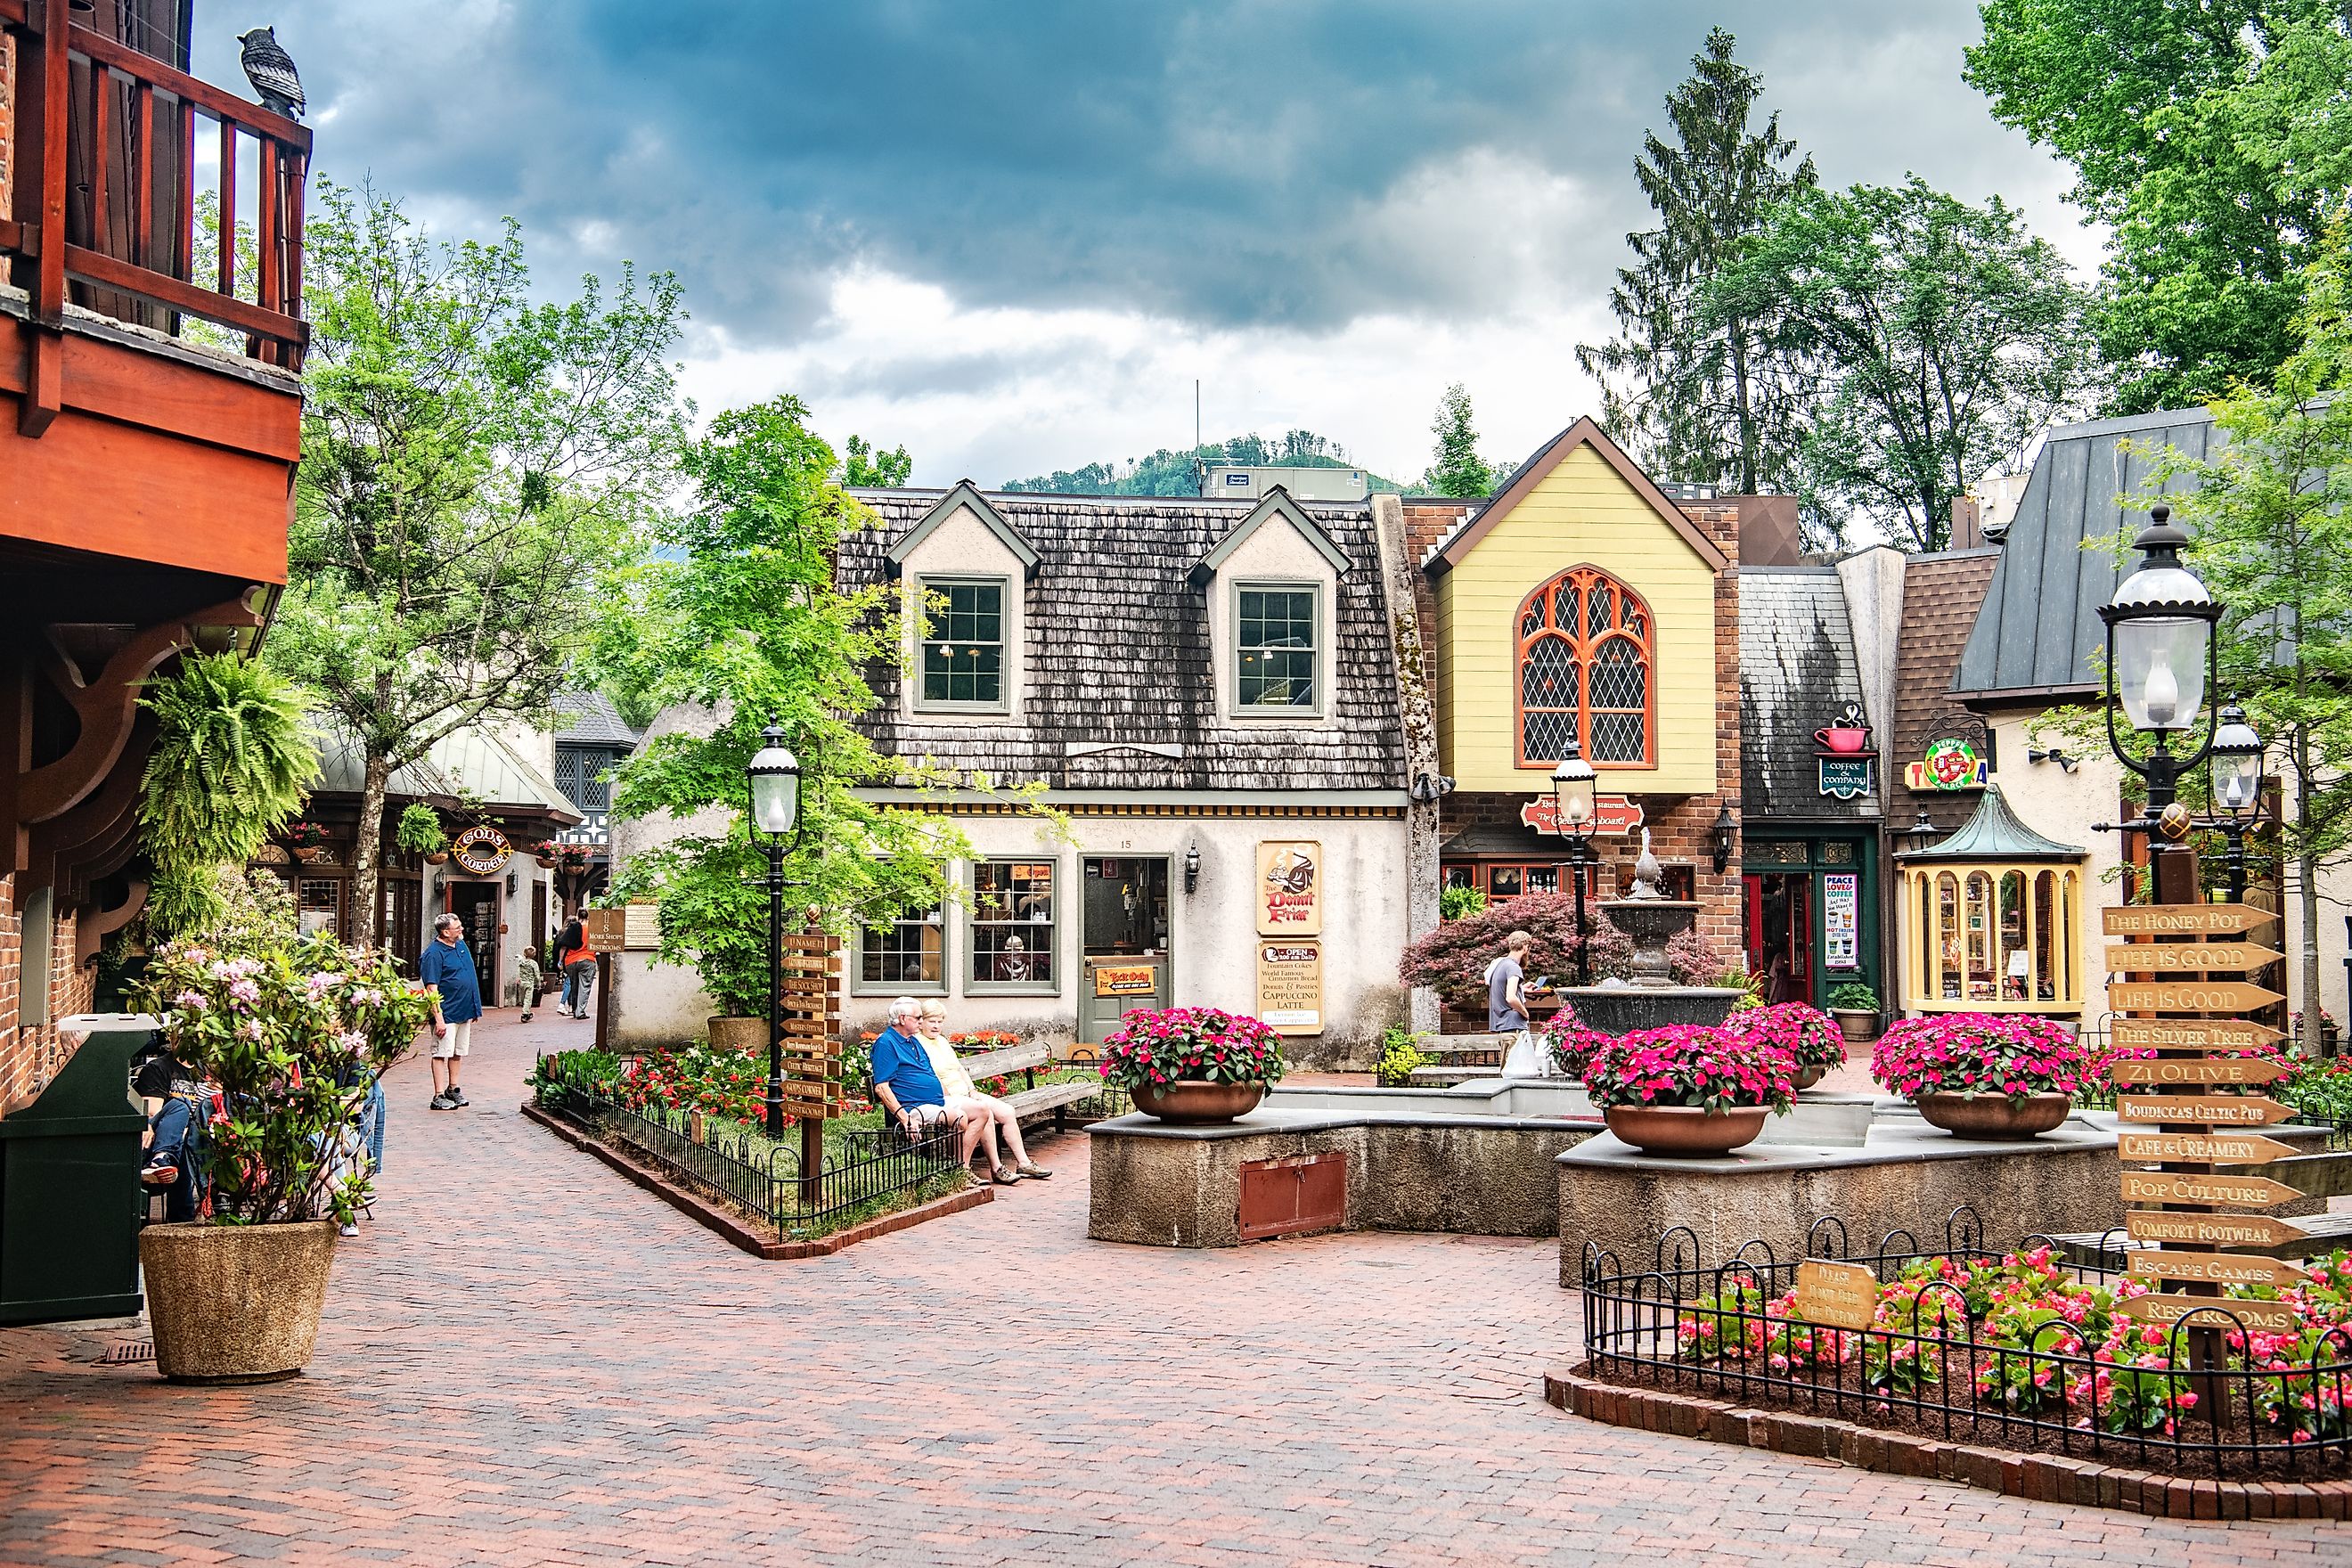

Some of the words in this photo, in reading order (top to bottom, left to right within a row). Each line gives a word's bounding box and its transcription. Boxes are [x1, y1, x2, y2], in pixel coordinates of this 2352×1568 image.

[1936, 740, 1965, 749] PEPPER
[1824, 776, 1866, 785] COMPANY
[1936, 780, 1964, 789] PALACE
[1121, 841, 1131, 849] 15
[461, 853, 506, 871] CORNER
[1266, 892, 1315, 907] Donut
[1266, 907, 1309, 923] Friar
[2107, 914, 2140, 930] THE
[2144, 914, 2203, 930] HONEY
[2209, 912, 2243, 928] POT
[603, 924, 609, 933] 8
[796, 939, 816, 947] NAME
[817, 940, 824, 948] IT
[2111, 951, 2153, 966] LIFE
[2159, 950, 2177, 966] IS
[2180, 950, 2246, 966] GOOD
[788, 980, 797, 989] THE
[798, 981, 810, 990] SOCK
[811, 981, 823, 991] SHOP
[1286, 982, 1293, 990] &
[1263, 991, 1317, 1000] CAPPUCCINO
[2115, 990, 2154, 1008] LIFE
[2159, 990, 2175, 1008] IS
[2179, 989, 2238, 1008] GOOD
[2115, 1026, 2149, 1043] THE
[2152, 1027, 2207, 1045] SILVER
[2210, 1028, 2252, 1045] TREE
[787, 1061, 802, 1070] CELTIC
[802, 1062, 823, 1073] HERITAGE
[2128, 1065, 2152, 1081] ZI
[2160, 1065, 2243, 1081] OLIVE
[802, 1085, 822, 1096] CORNER
[788, 1104, 823, 1116] RESTROOMS
[2124, 1102, 2193, 1119] BOUDICCA'S
[2195, 1103, 2237, 1119] CELTIC
[2240, 1105, 2264, 1120] PUB
[2125, 1136, 2162, 1156] CAFE
[2164, 1141, 2176, 1154] &
[2177, 1138, 2257, 1159] CREAMERY
[2128, 1179, 2168, 1197] POP
[2172, 1181, 2269, 1202] CULTURE
[2132, 1220, 2194, 1239] COMFORT
[2198, 1223, 2272, 1243] FOOTWEAR
[1819, 1265, 1850, 1285] PLEASE
[2134, 1256, 2202, 1277] ESCAPE
[2207, 1261, 2274, 1281] GAMES
[1807, 1302, 1822, 1319] THE
[1825, 1305, 1862, 1325] PIGEONS
[2146, 1301, 2289, 1328] RESTROOMS
